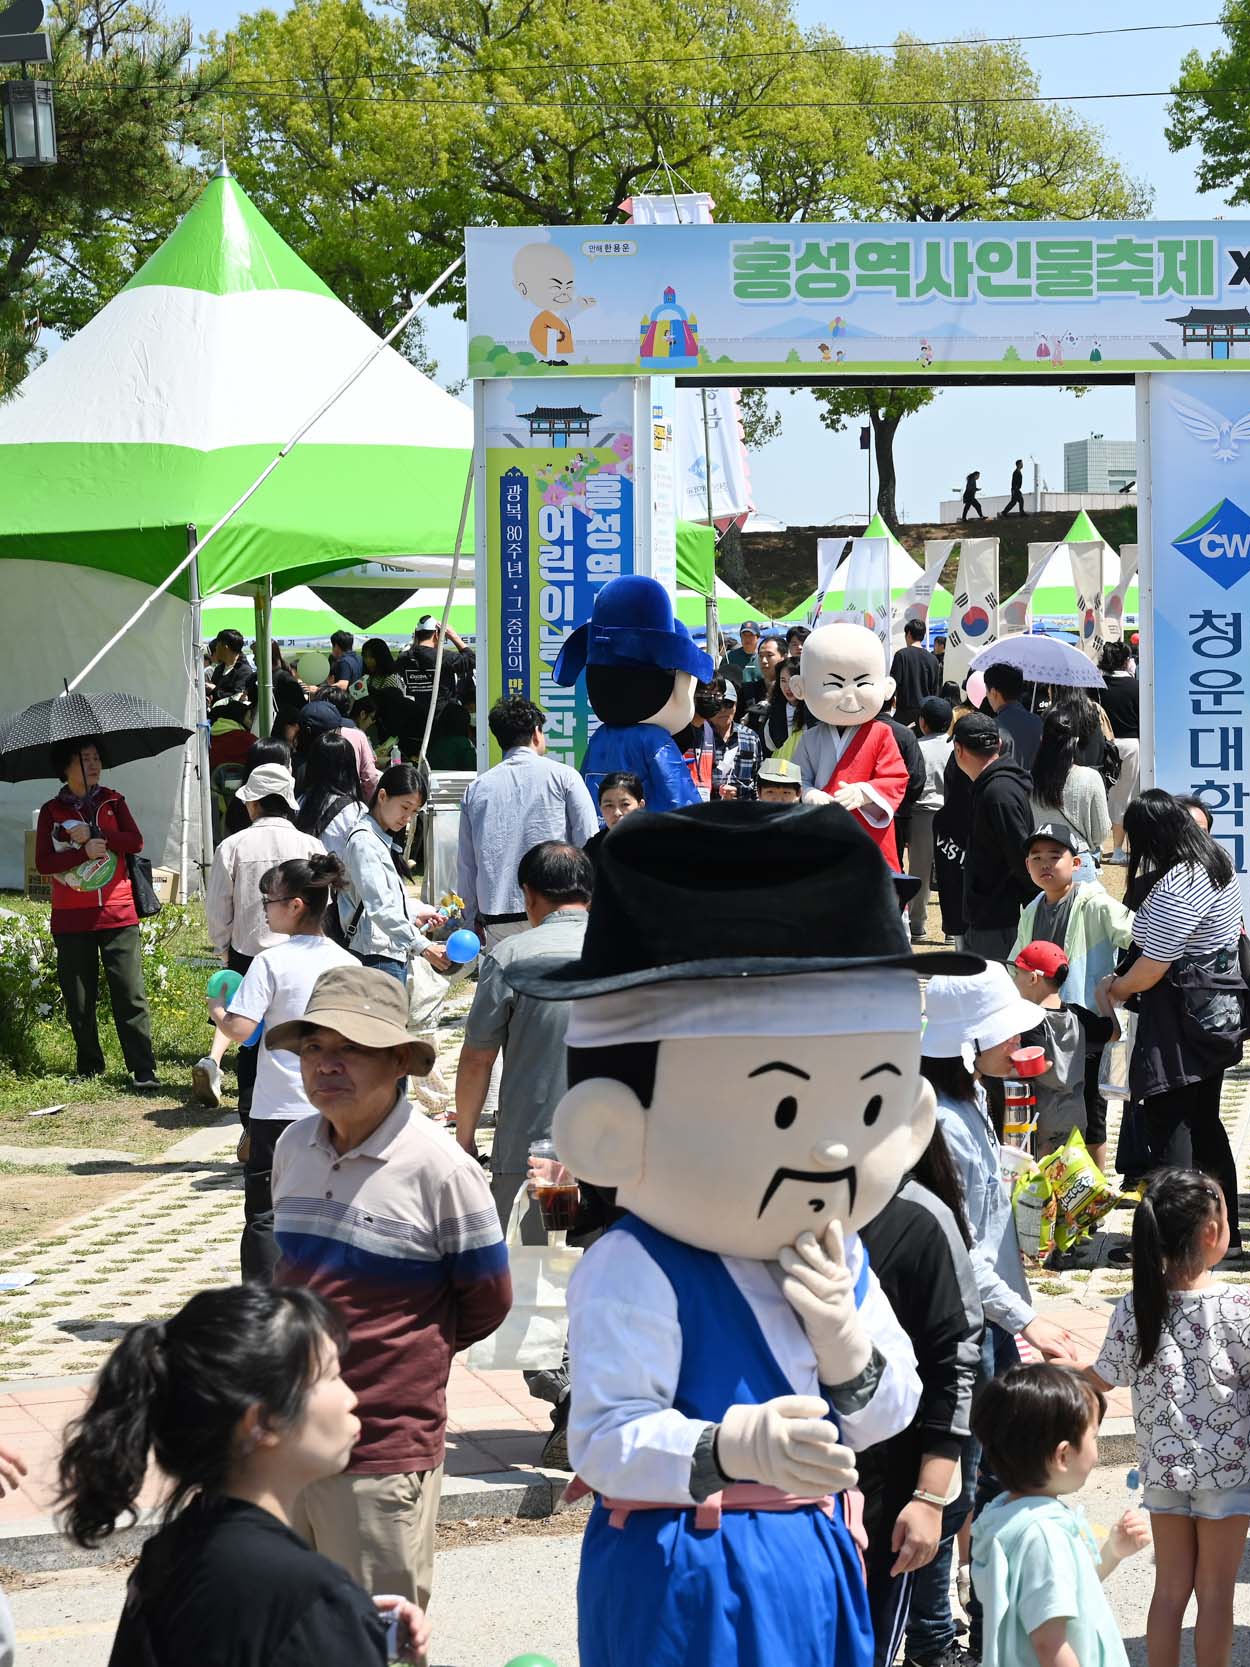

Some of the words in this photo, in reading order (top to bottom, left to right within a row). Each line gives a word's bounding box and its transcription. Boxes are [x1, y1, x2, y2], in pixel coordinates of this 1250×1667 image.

[506, 484, 522, 520] 광복
[506, 525, 522, 579] 80주년
[507, 597, 522, 612] 그
[507, 619, 523, 673] 중심의
